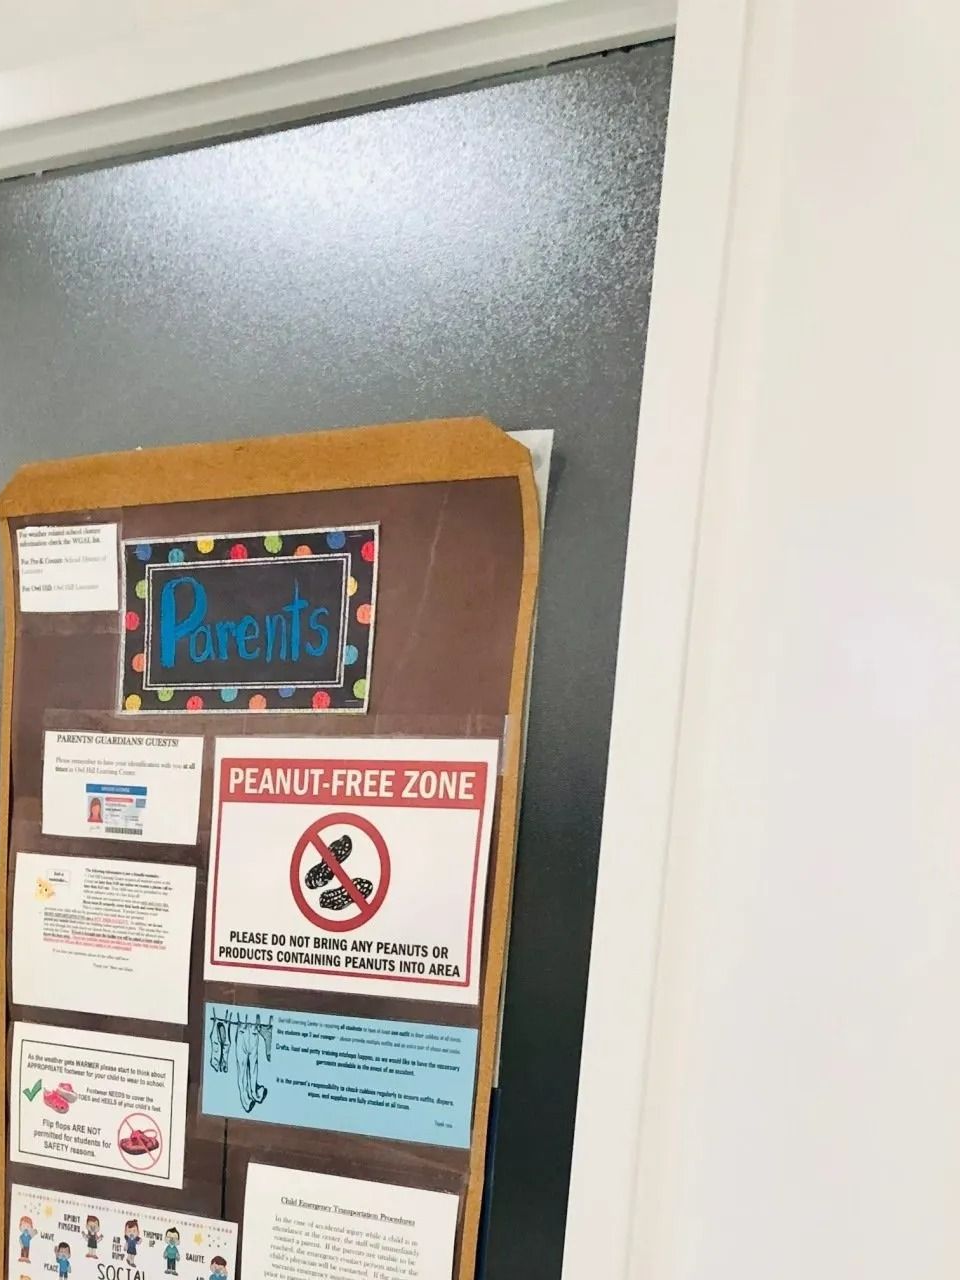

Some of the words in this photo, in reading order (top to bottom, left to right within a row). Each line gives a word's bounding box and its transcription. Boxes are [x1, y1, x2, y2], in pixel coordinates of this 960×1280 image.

[160, 576, 329, 669] Parents
[56, 733, 94, 744] PARENTS!
[94, 735, 144, 745] GUARDIANS!
[144, 737, 179, 747] GUESTS!
[228, 767, 396, 798] PEANUT-FREE
[401, 771, 476, 800] ZONE
[229, 930, 268, 946] PLEASE
[271, 933, 286, 947] DO
[290, 935, 310, 948] NOT
[313, 937, 348, 951] BRING
[350, 939, 374, 953] ANY
[376, 942, 429, 958] PEANUTS
[432, 946, 449, 959] OR
[218, 946, 274, 962] PRODUCTS
[276, 950, 341, 968] CONTAINING
[344, 956, 396, 972] PEANUTS
[399, 961, 425, 975] INTO
[428, 964, 460, 978] AREA
[26, 1061, 63, 1073] APPROPRIATE
[63, 1066, 85, 1076] footwear
[85, 1069, 93, 1077] for
[106, 1073, 119, 1081] child
[139, 1077, 145, 1085] to
[27, 1052, 34, 1060] As
[34, 1053, 43, 1061] the
[43, 1056, 63, 1064] weather
[75, 1059, 99, 1069] WARMER
[99, 1063, 117, 1072] please
[129, 1067, 136, 1075] to
[136, 1068, 150, 1076] think
[150, 1070, 166, 1078] about
[42, 1118, 54, 1129] Flip
[54, 1120, 70, 1131] flops
[71, 1123, 85, 1134] ARE
[86, 1125, 101, 1135] NOT
[32, 1129, 63, 1140] permitted
[63, 1133, 73, 1142] for
[73, 1135, 101, 1147] students
[101, 1140, 111, 1148] for
[43, 1140, 68, 1152] SAFETY
[280, 1196, 297, 1206] Child
[297, 1198, 331, 1212] Emergency
[331, 1204, 378, 1220] Transportation
[379, 1212, 415, 1226] Procedures
[40, 1232, 54, 1241] WAVE
[44, 1263, 59, 1273] PEACE
[185, 1253, 205, 1264] SALUTE
